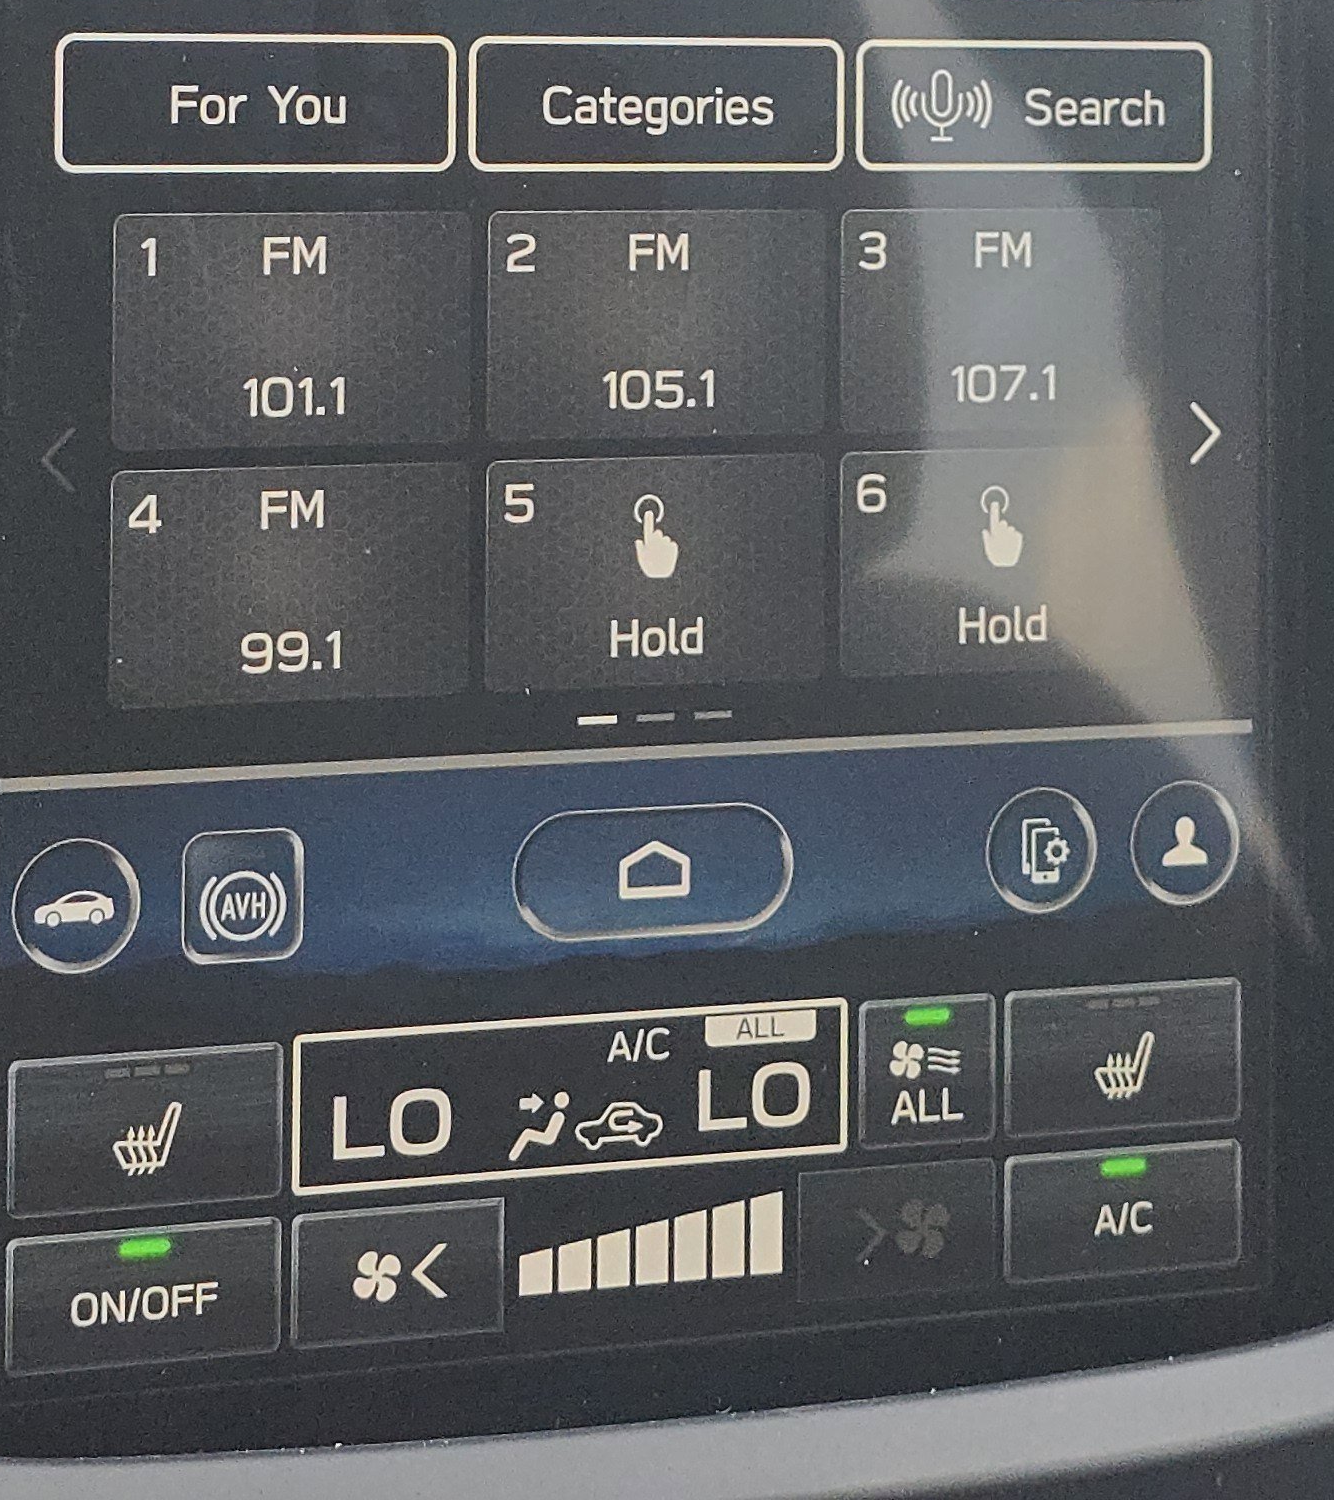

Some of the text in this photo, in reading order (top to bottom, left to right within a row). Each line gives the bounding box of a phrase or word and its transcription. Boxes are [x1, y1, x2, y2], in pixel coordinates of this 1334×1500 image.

[170, 85, 347, 126] For You
[543, 85, 774, 136] Categories
[1024, 88, 1165, 128] Search
[141, 237, 157, 277] 1
[263, 236, 327, 276] FM
[506, 234, 536, 273] 2
[629, 233, 689, 271] FM
[858, 231, 887, 270] 3
[974, 231, 1032, 268] FM
[242, 376, 346, 418] 101.1
[602, 369, 715, 410] 105.1
[951, 364, 1056, 401] 107.1
[260, 490, 325, 530] FM
[503, 483, 535, 524] 5
[857, 473, 887, 514] 6
[128, 494, 162, 534] 4
[610, 616, 704, 658] Hold
[958, 604, 1048, 645] Hold
[240, 630, 342, 674] 99.1
[221, 893, 266, 921] AVH
[607, 1017, 785, 1062] A/C ALL
[697, 1061, 811, 1132] LO
[891, 1086, 964, 1125] ALL
[333, 1087, 453, 1160] LO
[1094, 1200, 1153, 1238] A/C
[71, 1281, 219, 1328] ON/OFF
